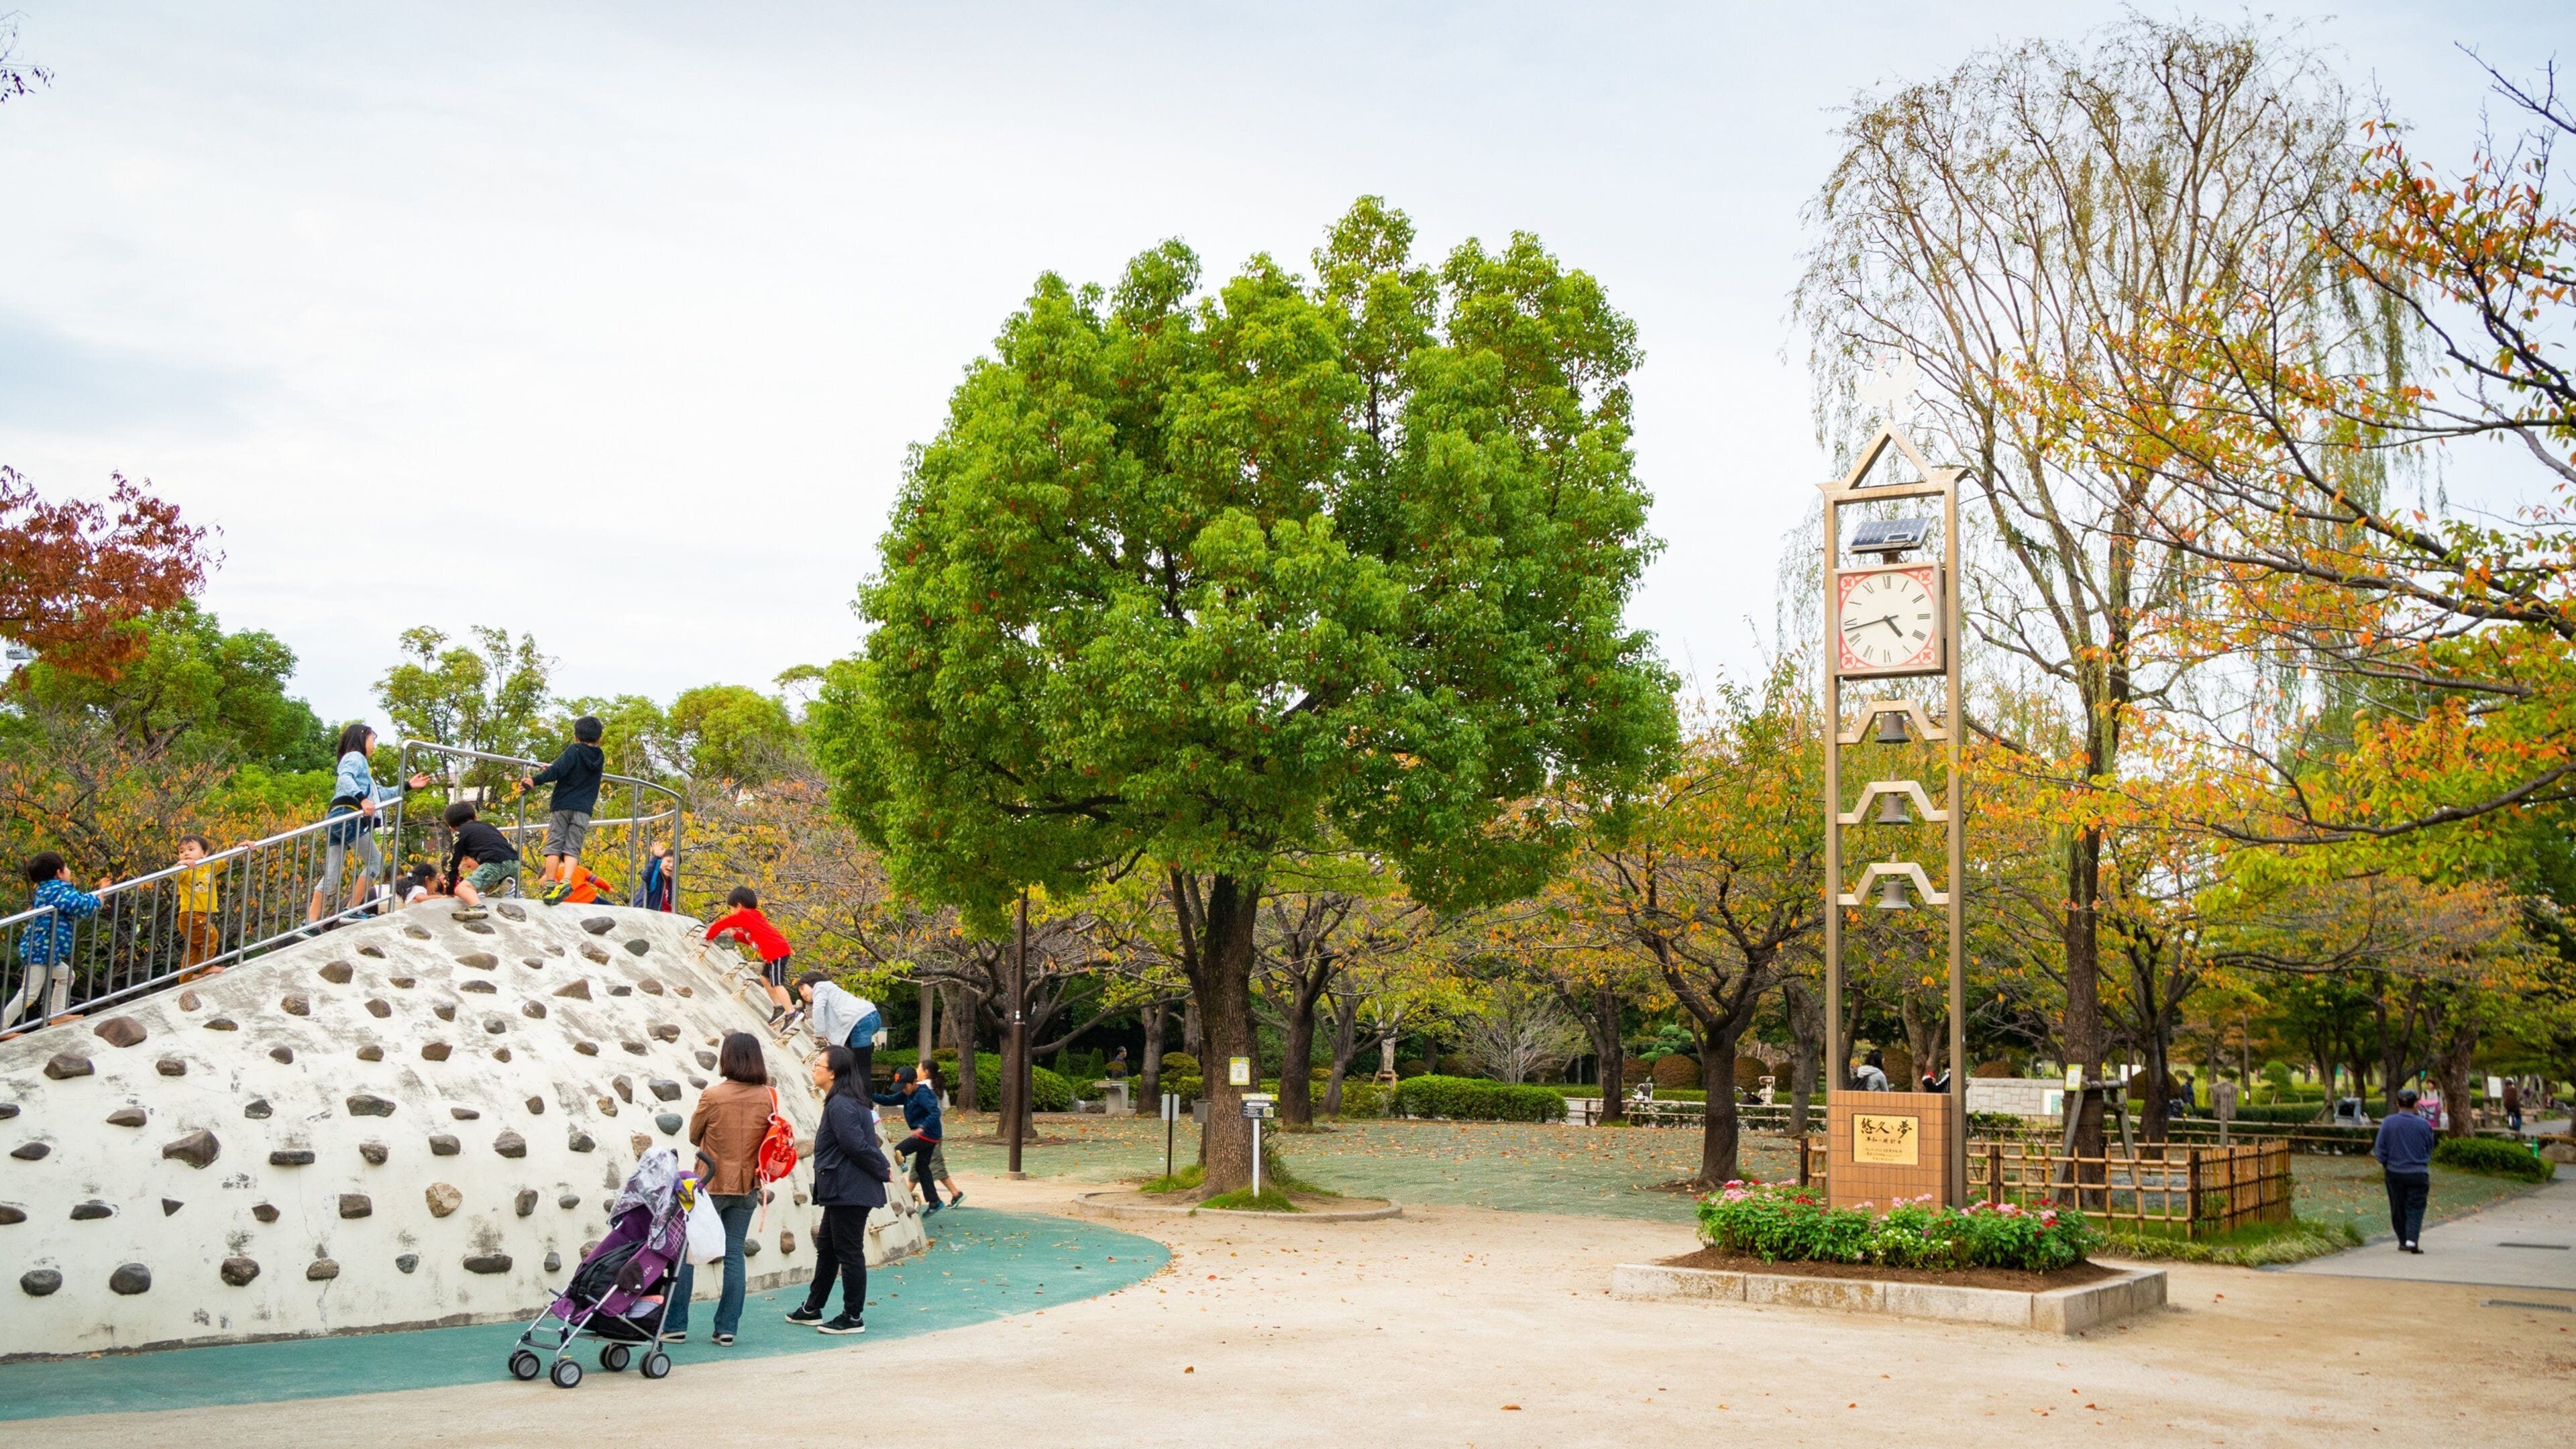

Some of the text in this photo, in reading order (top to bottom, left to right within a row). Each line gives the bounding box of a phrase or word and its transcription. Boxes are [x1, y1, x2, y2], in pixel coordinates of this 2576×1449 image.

[1862, 581, 1875, 596] XI
[1882, 576, 1891, 590] XII
[1901, 580, 1909, 592] I
[1912, 593, 1925, 604] II
[1912, 629, 1927, 641] IIII
[1883, 649, 1892, 663] VI
